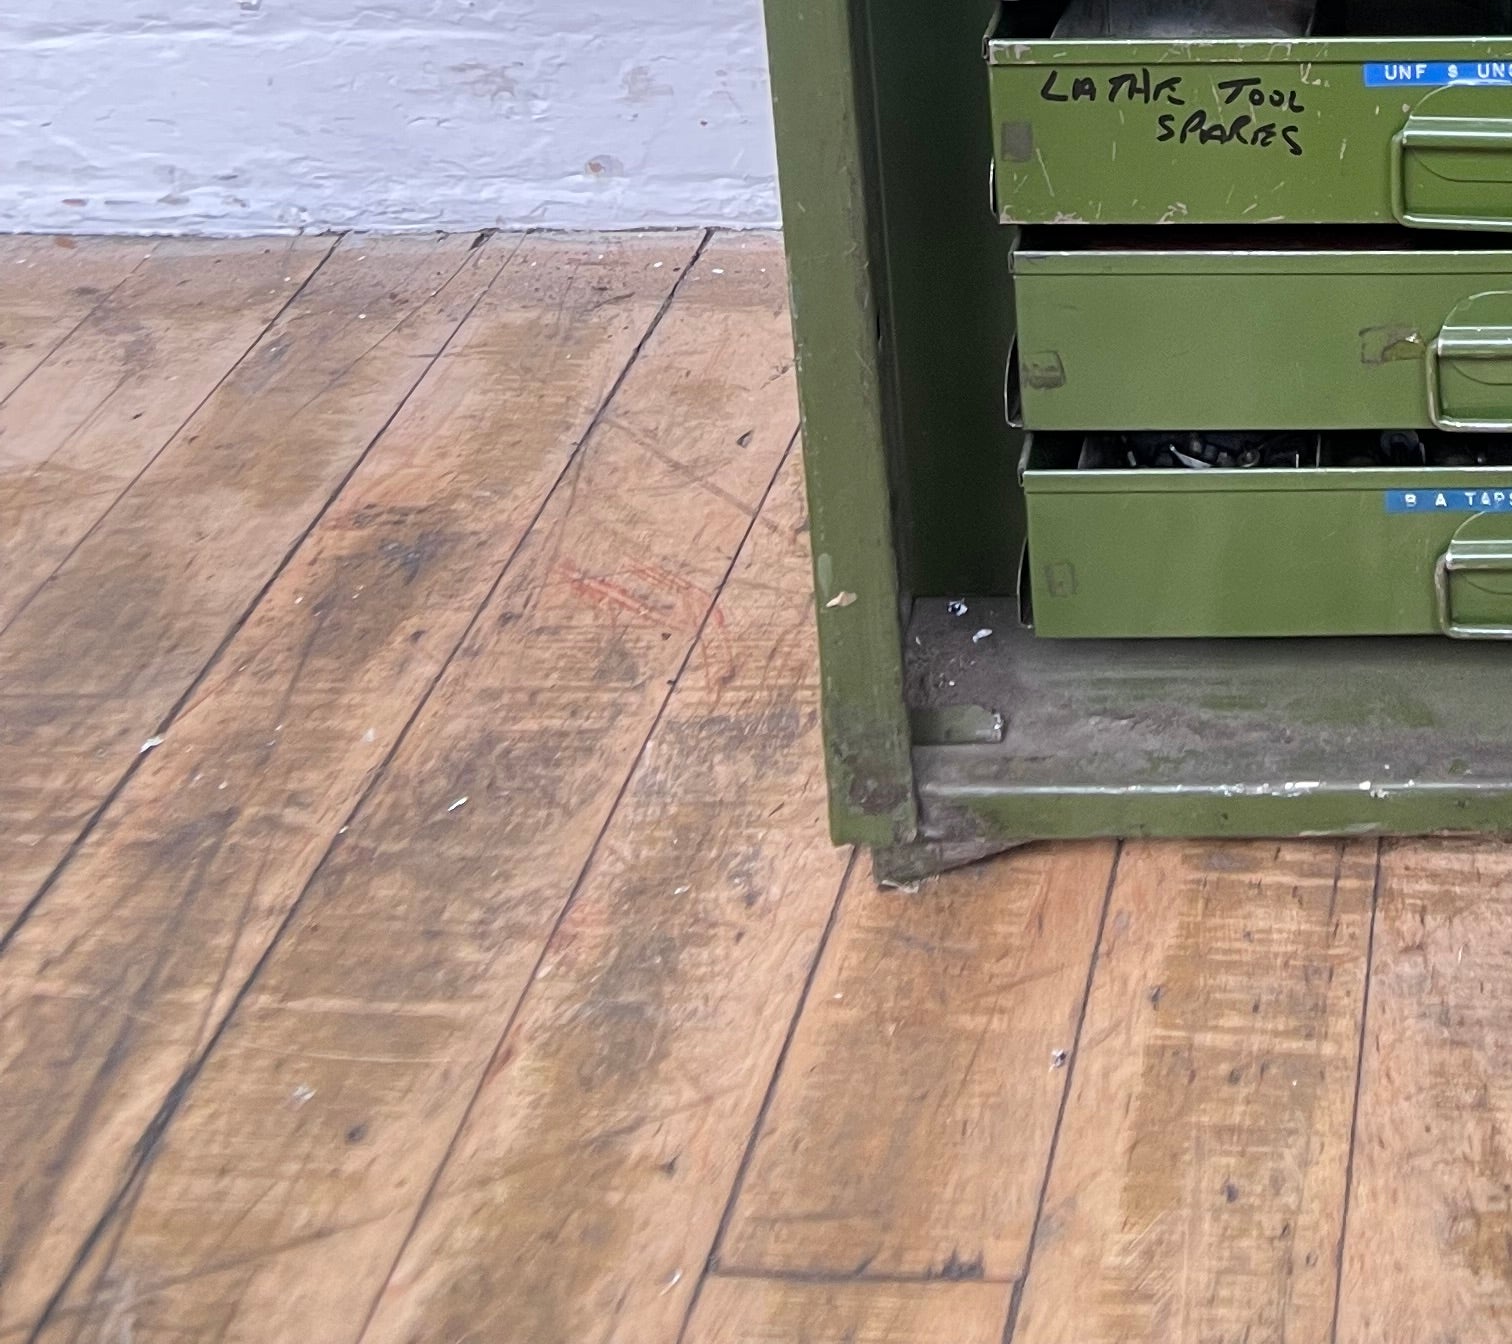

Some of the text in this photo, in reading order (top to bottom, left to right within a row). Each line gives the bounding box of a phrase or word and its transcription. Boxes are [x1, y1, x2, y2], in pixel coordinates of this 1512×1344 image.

[1384, 64, 1427, 81] UNF
[1218, 77, 1305, 113] TOOL
[1156, 109, 1303, 156] SPARES
